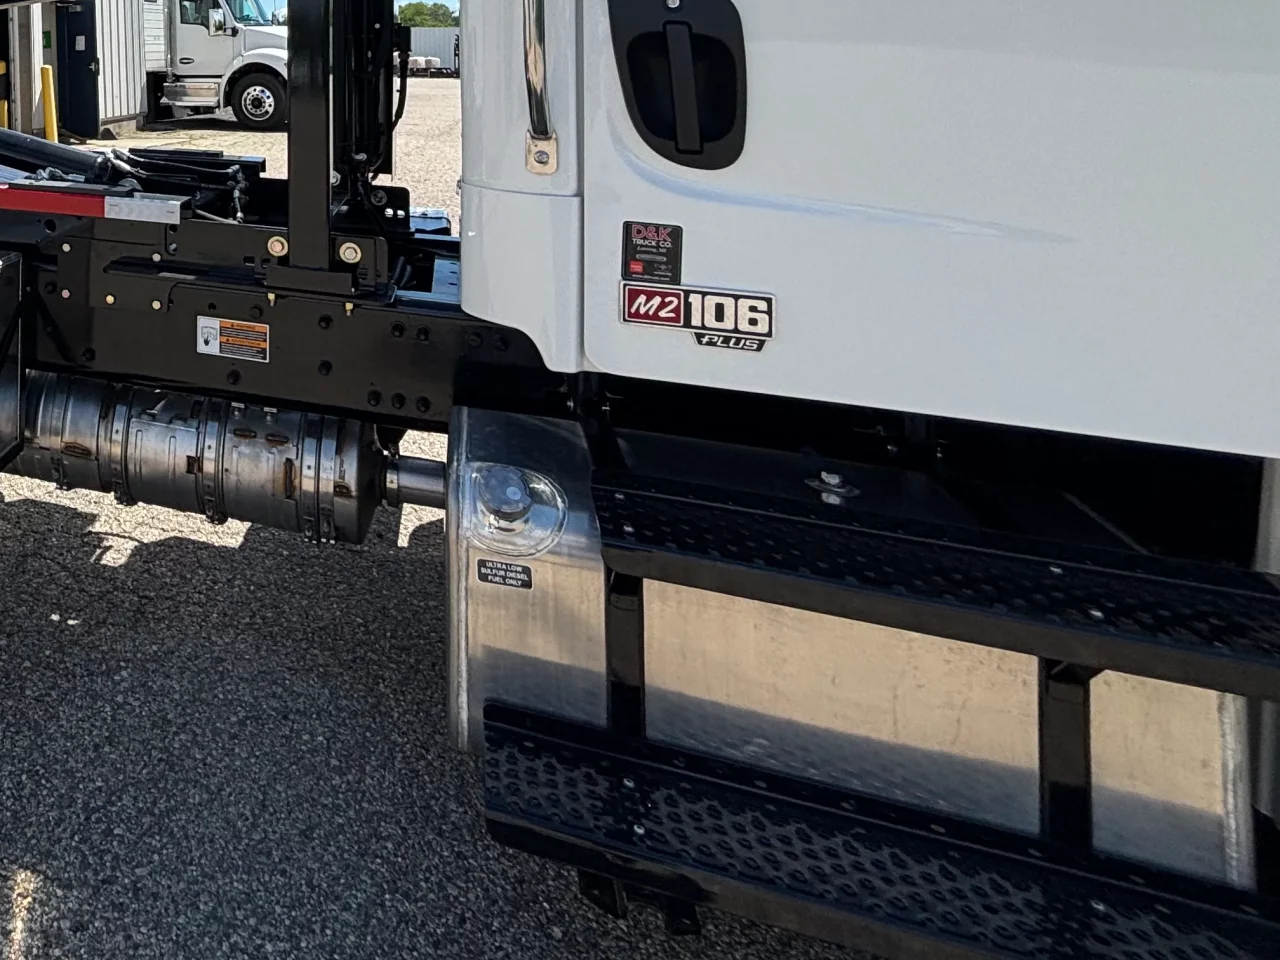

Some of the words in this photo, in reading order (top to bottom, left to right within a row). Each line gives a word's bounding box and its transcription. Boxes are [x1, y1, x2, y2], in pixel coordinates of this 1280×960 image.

[631, 224, 672, 242] D&K
[631, 238, 657, 247] TRUCK
[630, 293, 679, 318] M2
[688, 293, 770, 334] 106
[700, 334, 760, 350] PLUS
[486, 561, 507, 569] ULTRA
[507, 564, 523, 572] LOW
[481, 567, 505, 576] SULFUR
[507, 571, 529, 580] DIESEL
[488, 575, 504, 583] FUEL
[505, 578, 522, 587] ONLY
